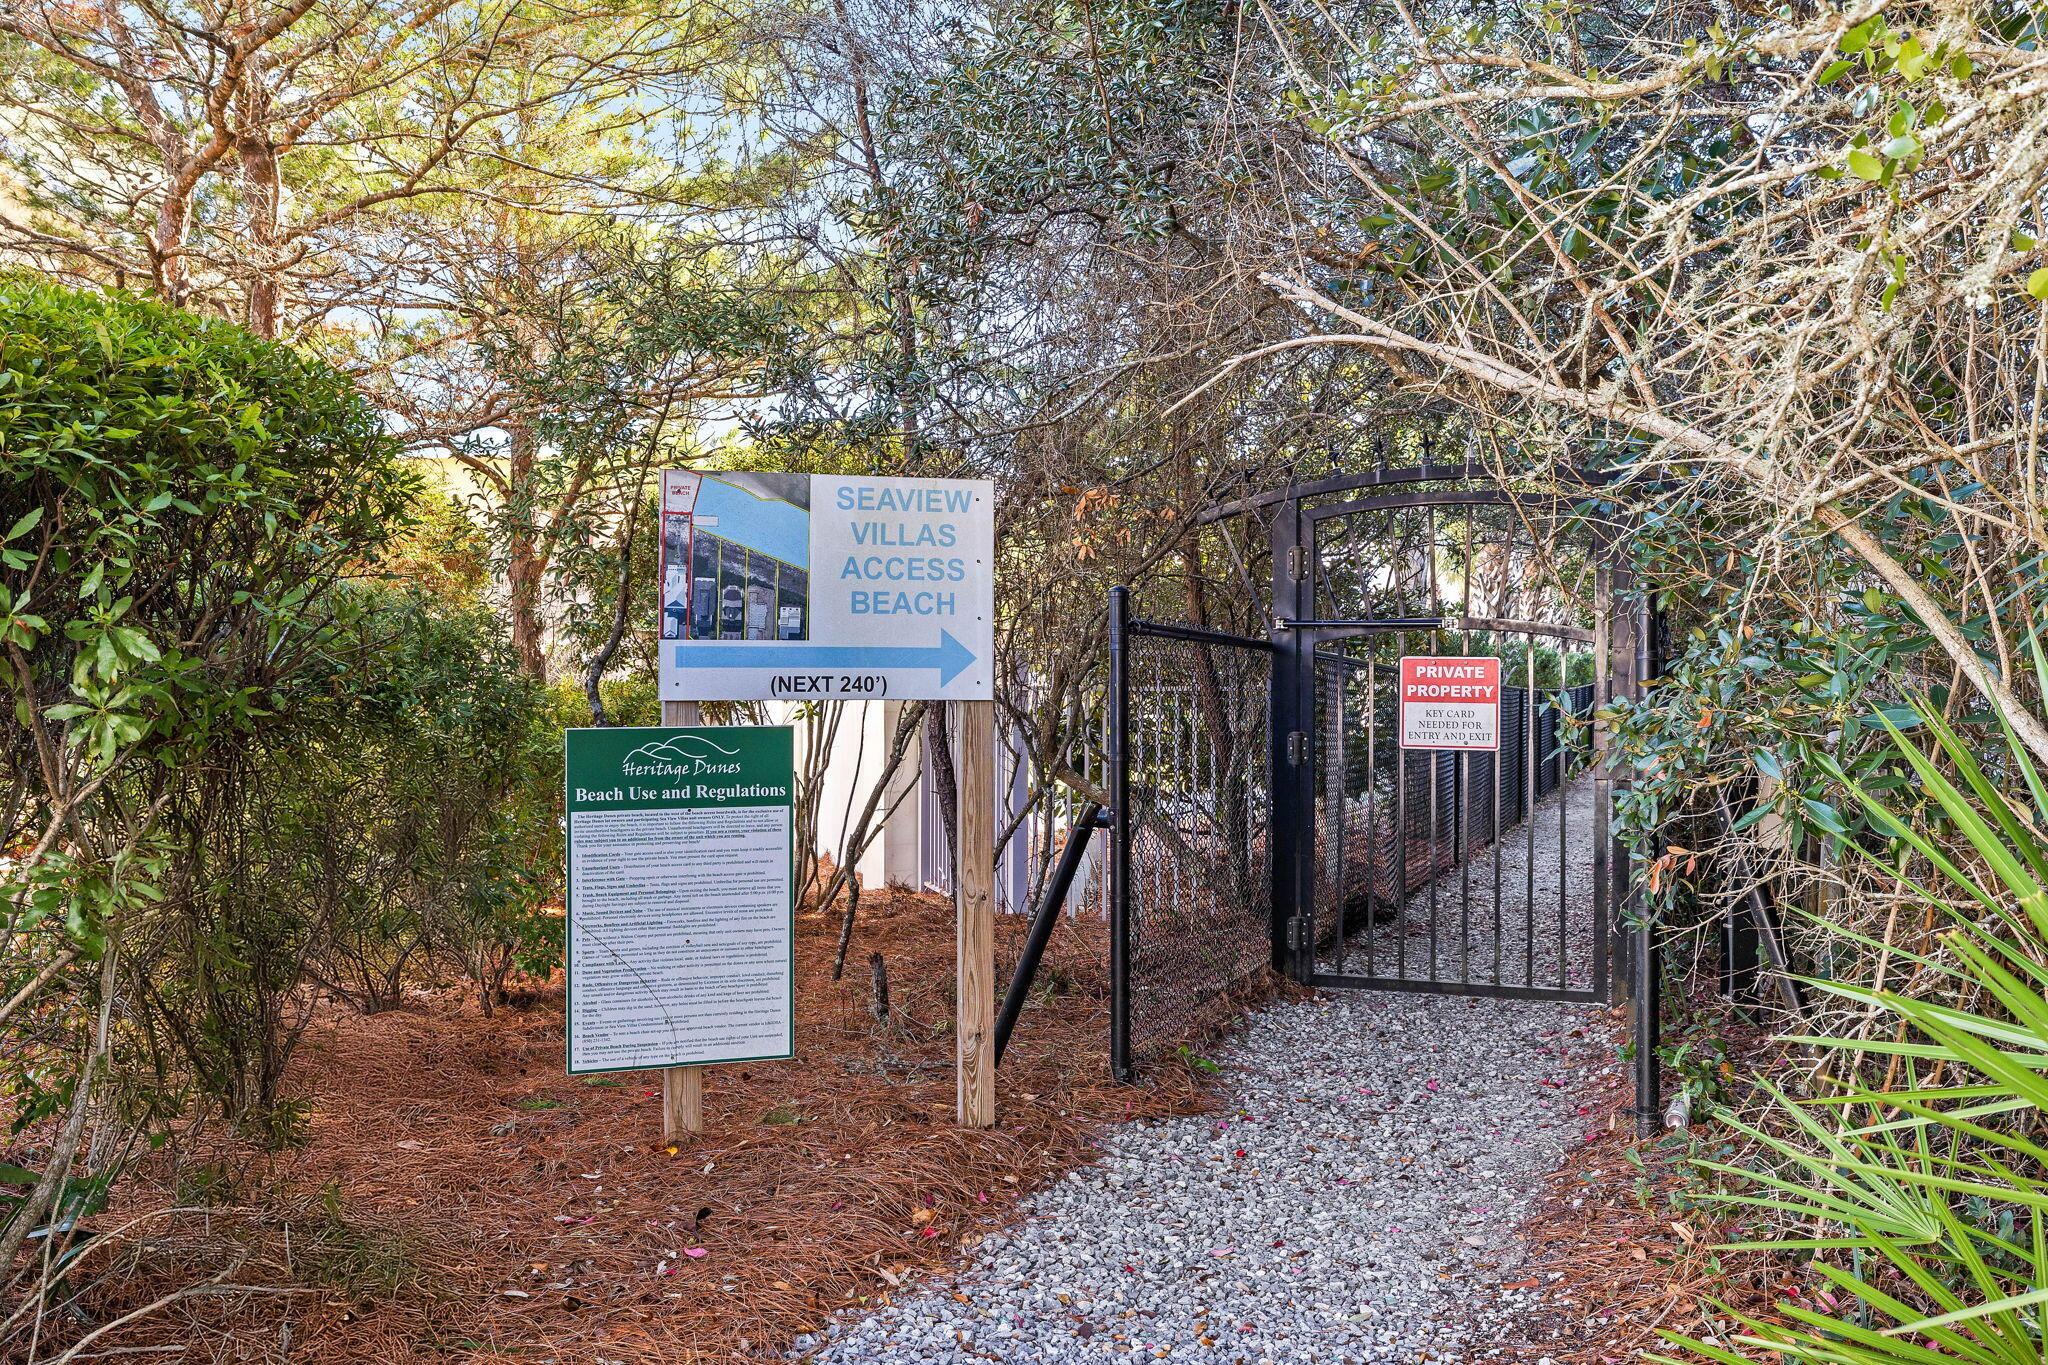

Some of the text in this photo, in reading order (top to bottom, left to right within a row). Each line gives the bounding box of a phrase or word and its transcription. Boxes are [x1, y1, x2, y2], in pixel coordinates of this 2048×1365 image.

[836, 486, 972, 513] SEAVIEW
[851, 521, 956, 547] VILLAS
[840, 556, 966, 581] ACCESS
[851, 591, 955, 615] BEACH
[1416, 666, 1485, 679] PRIVATE
[771, 675, 833, 697] (NEXT
[1407, 685, 1494, 698] PROPERTY
[1425, 710, 1475, 718] KEY CARD
[1418, 720, 1483, 730] NEEDED FOR
[1408, 731, 1493, 741] ENTRY AND EXIT
[622, 759, 741, 784] Heritage Dunes
[575, 783, 786, 802] Beach Use and Regulations
